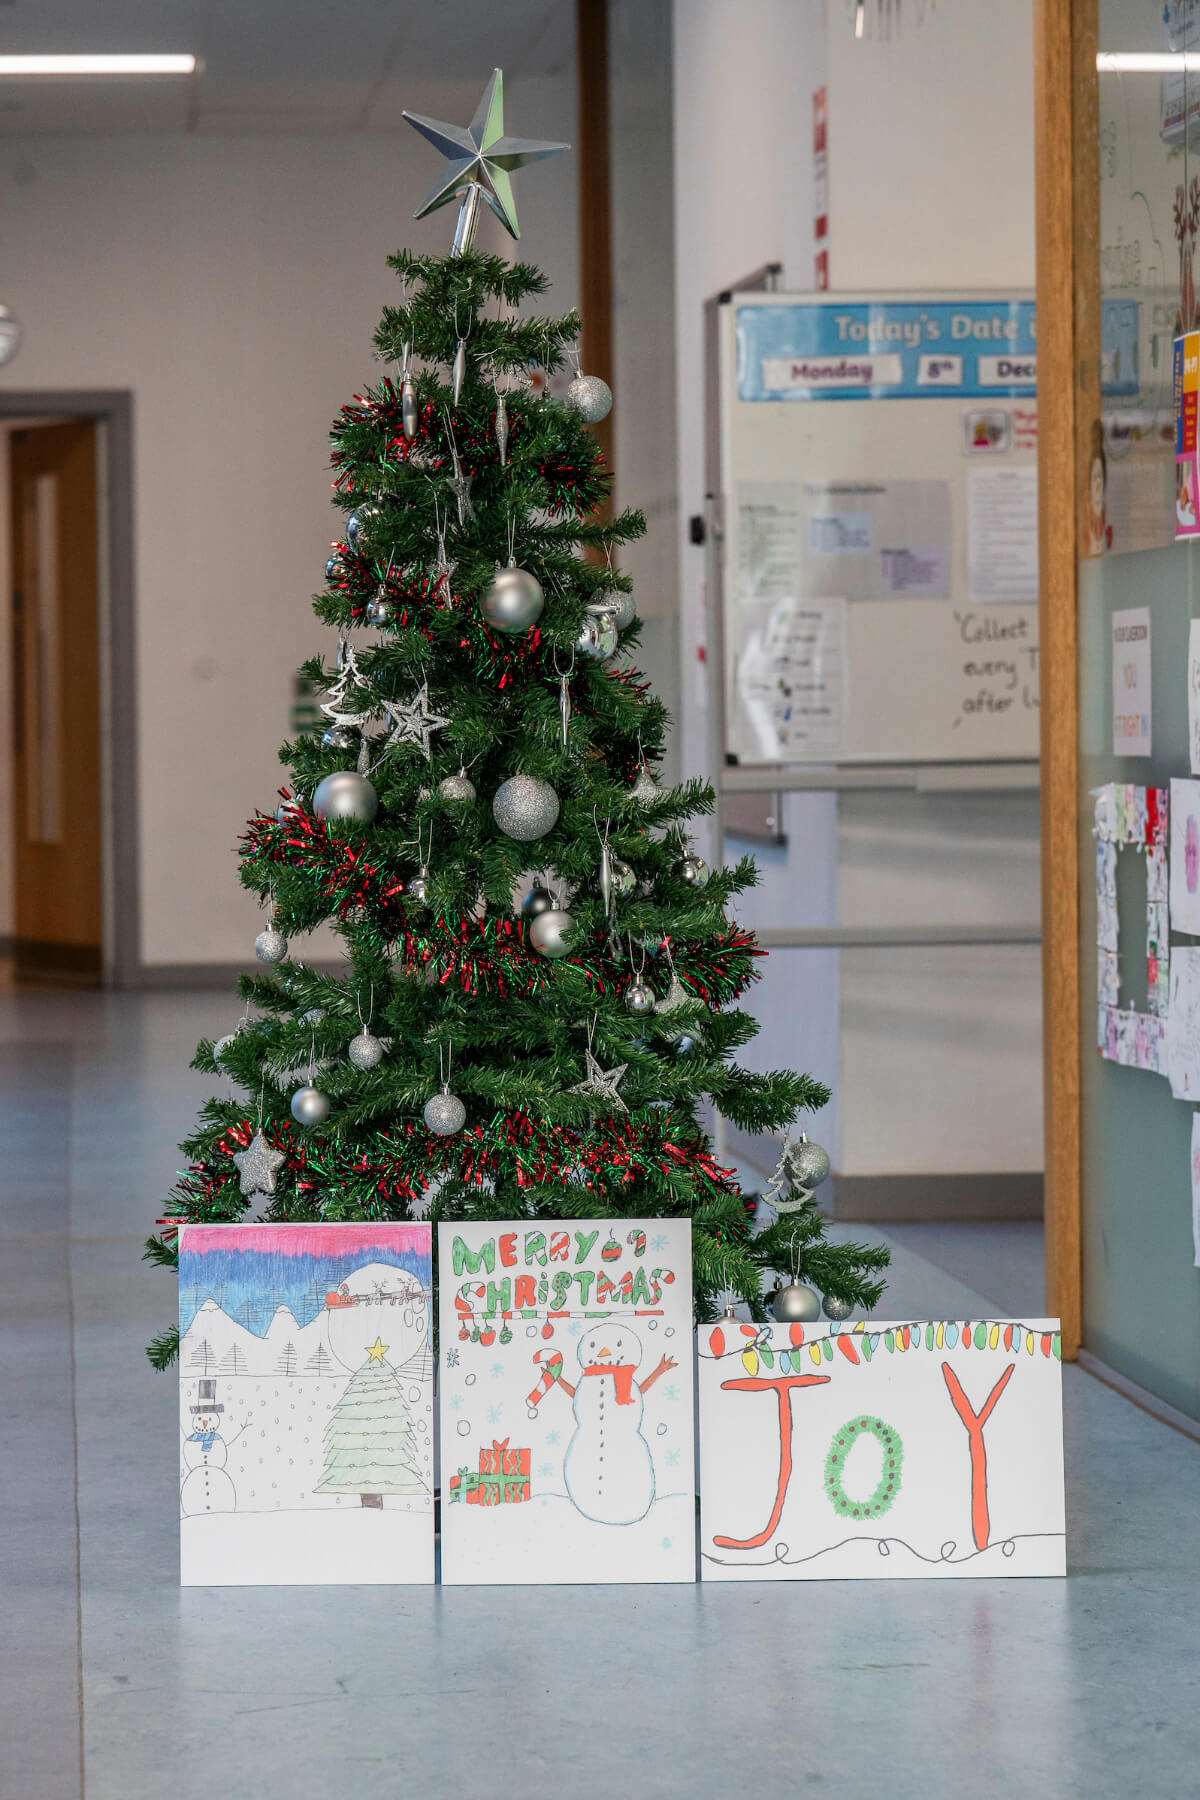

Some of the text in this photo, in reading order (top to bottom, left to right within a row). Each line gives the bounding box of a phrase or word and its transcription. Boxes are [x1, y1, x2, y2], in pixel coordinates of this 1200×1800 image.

[835, 314, 940, 347] Today's
[951, 315, 1018, 340] Date
[791, 361, 874, 384] Monday
[996, 360, 1038, 379] Dec
[960, 613, 1028, 643] Collect
[963, 661, 1018, 688] every
[963, 690, 1012, 713] after
[452, 1229, 600, 1277] MERRY
[713, 1361, 1016, 1551] JOY
